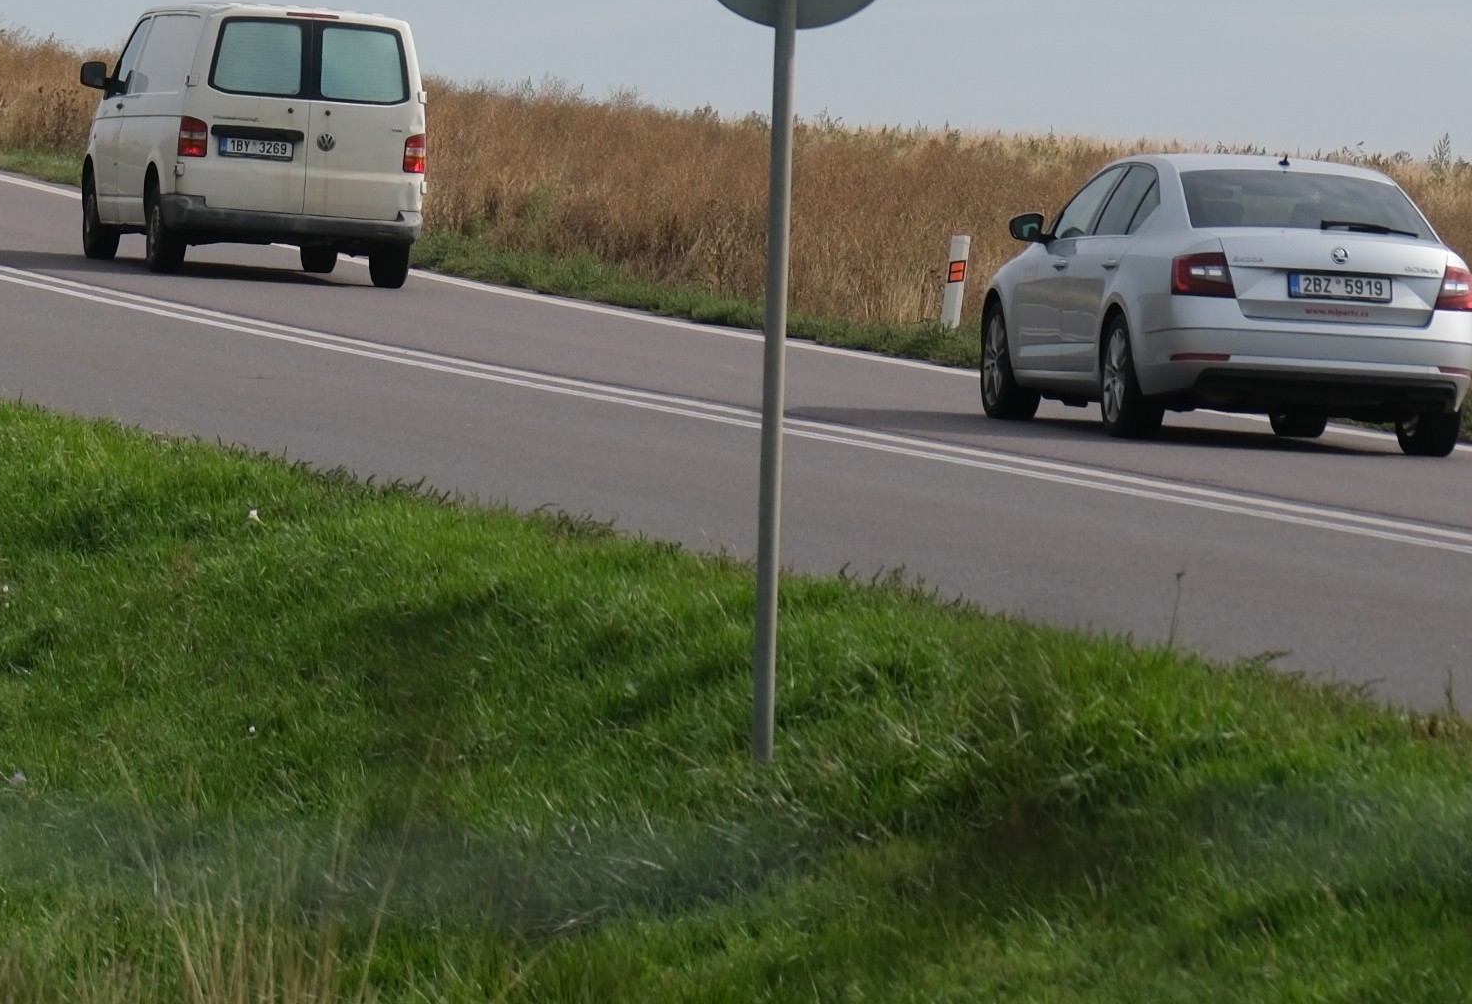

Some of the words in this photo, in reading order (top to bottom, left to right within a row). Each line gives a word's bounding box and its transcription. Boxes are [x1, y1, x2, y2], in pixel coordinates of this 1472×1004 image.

[230, 139, 251, 153] 1BY
[259, 142, 287, 155] 3269
[1303, 277, 1332, 294] 2BZ
[1344, 279, 1383, 296] 5919
